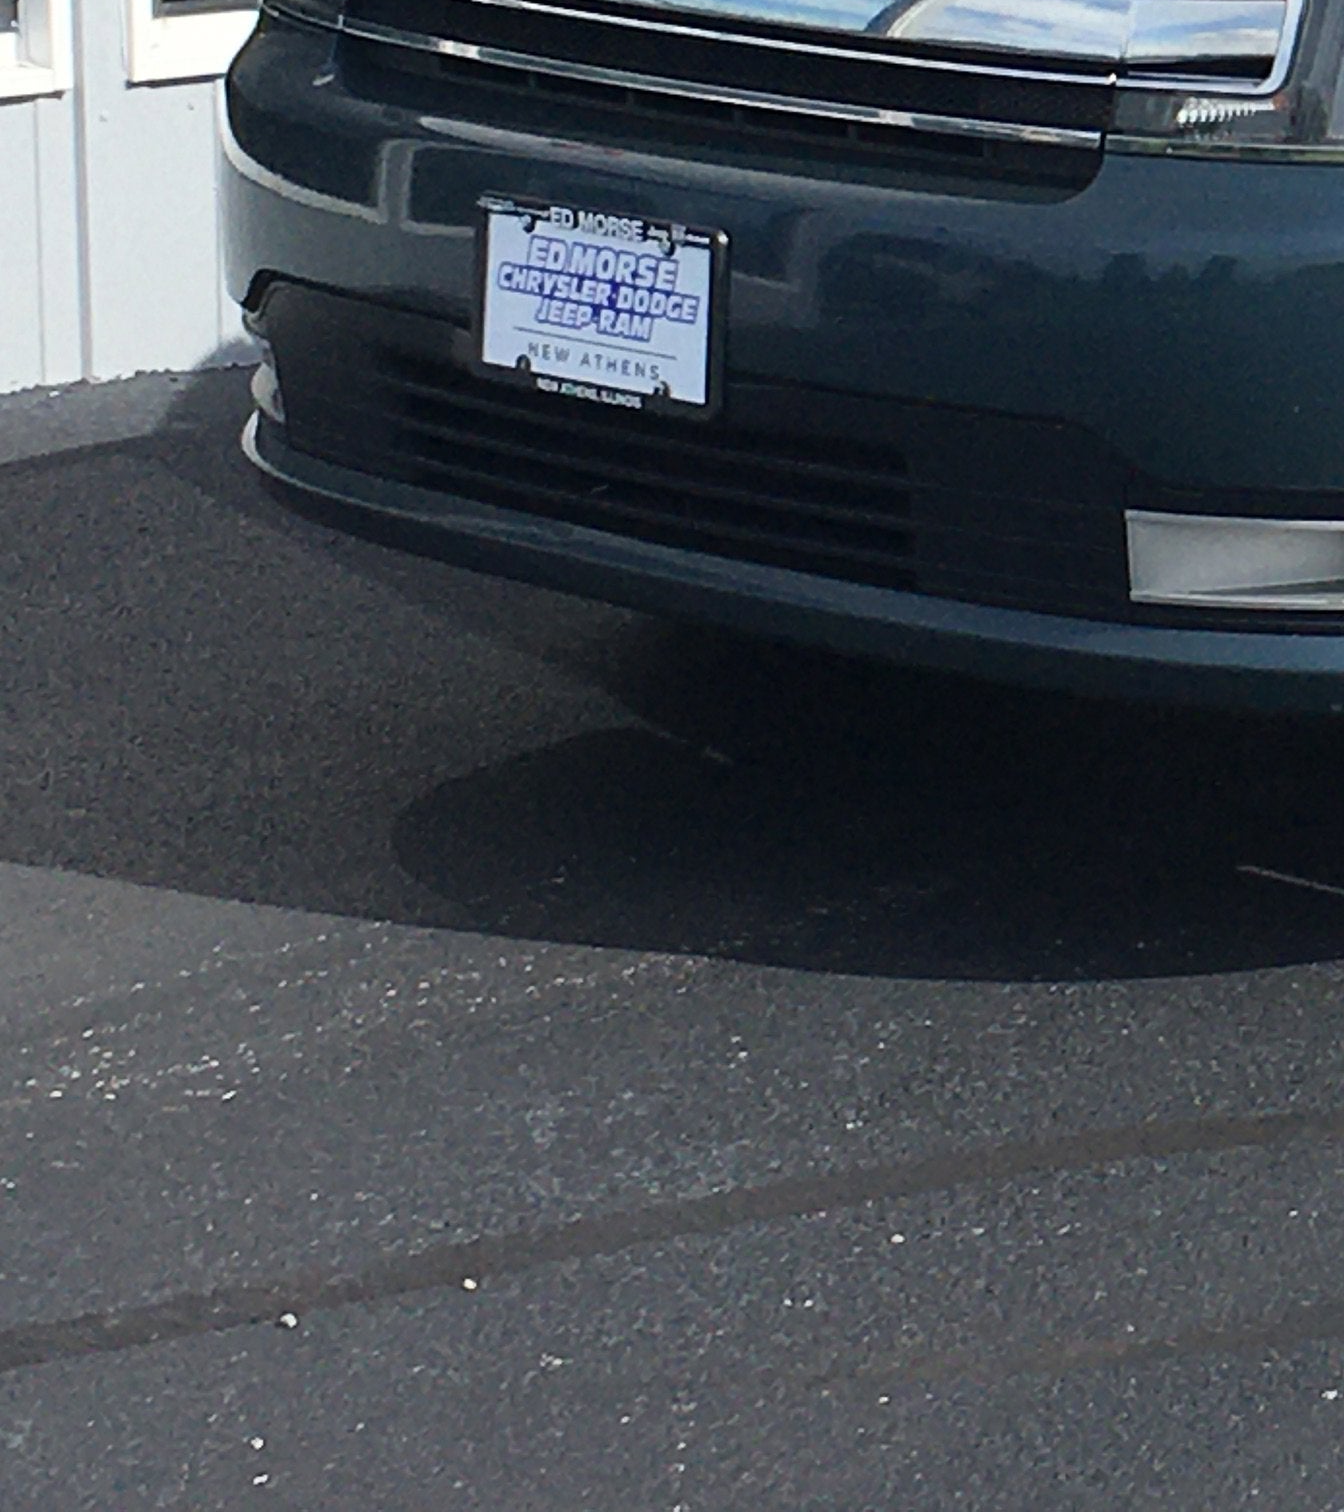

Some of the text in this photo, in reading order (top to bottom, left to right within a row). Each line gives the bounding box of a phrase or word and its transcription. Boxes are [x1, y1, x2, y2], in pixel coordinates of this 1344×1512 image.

[549, 206, 574, 230] ED
[577, 210, 645, 242] MORSE
[529, 235, 679, 291] ED MORSE
[528, 341, 661, 380] NEW ATHENS
